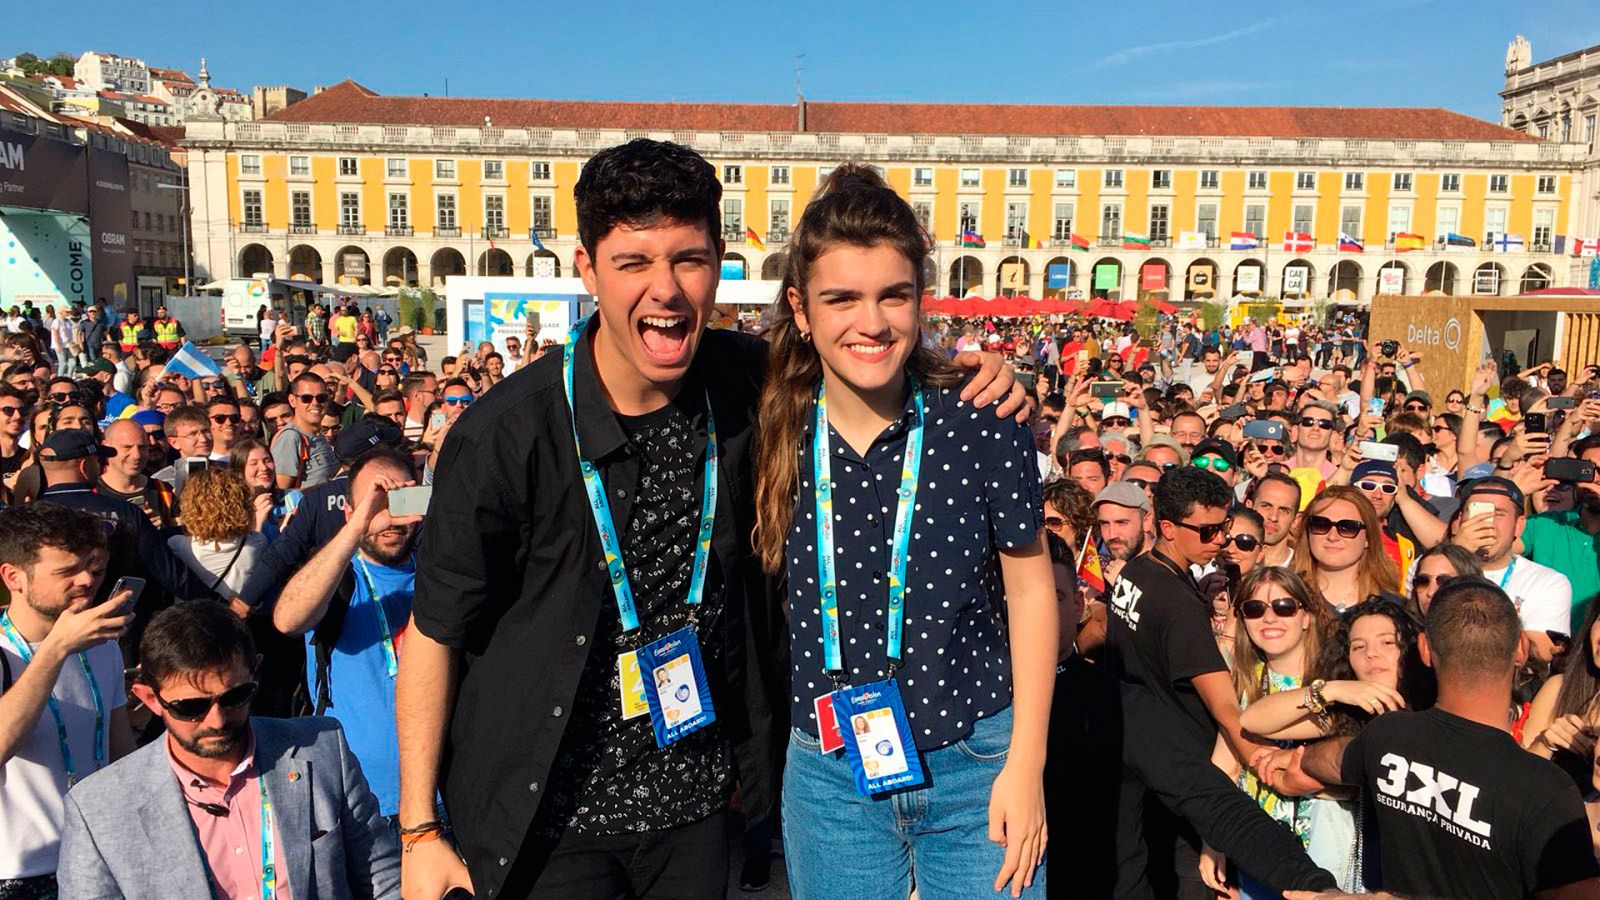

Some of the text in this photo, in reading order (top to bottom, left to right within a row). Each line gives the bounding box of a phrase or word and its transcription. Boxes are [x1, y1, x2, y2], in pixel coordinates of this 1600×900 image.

[0, 140, 24, 171] AM
[4, 181, 25, 193] Partner
[101, 232, 125, 246] OSRAM
[69, 242, 84, 304] LCOME
[1408, 324, 1440, 345] Delta
[327, 494, 347, 512] PO
[666, 715, 707, 740] ALL ABOARD!
[882, 774, 914, 787] ABOARD!
[1377, 752, 1491, 837] 3XL
[1376, 793, 1491, 850] SEGURANÇA PRIVADA
